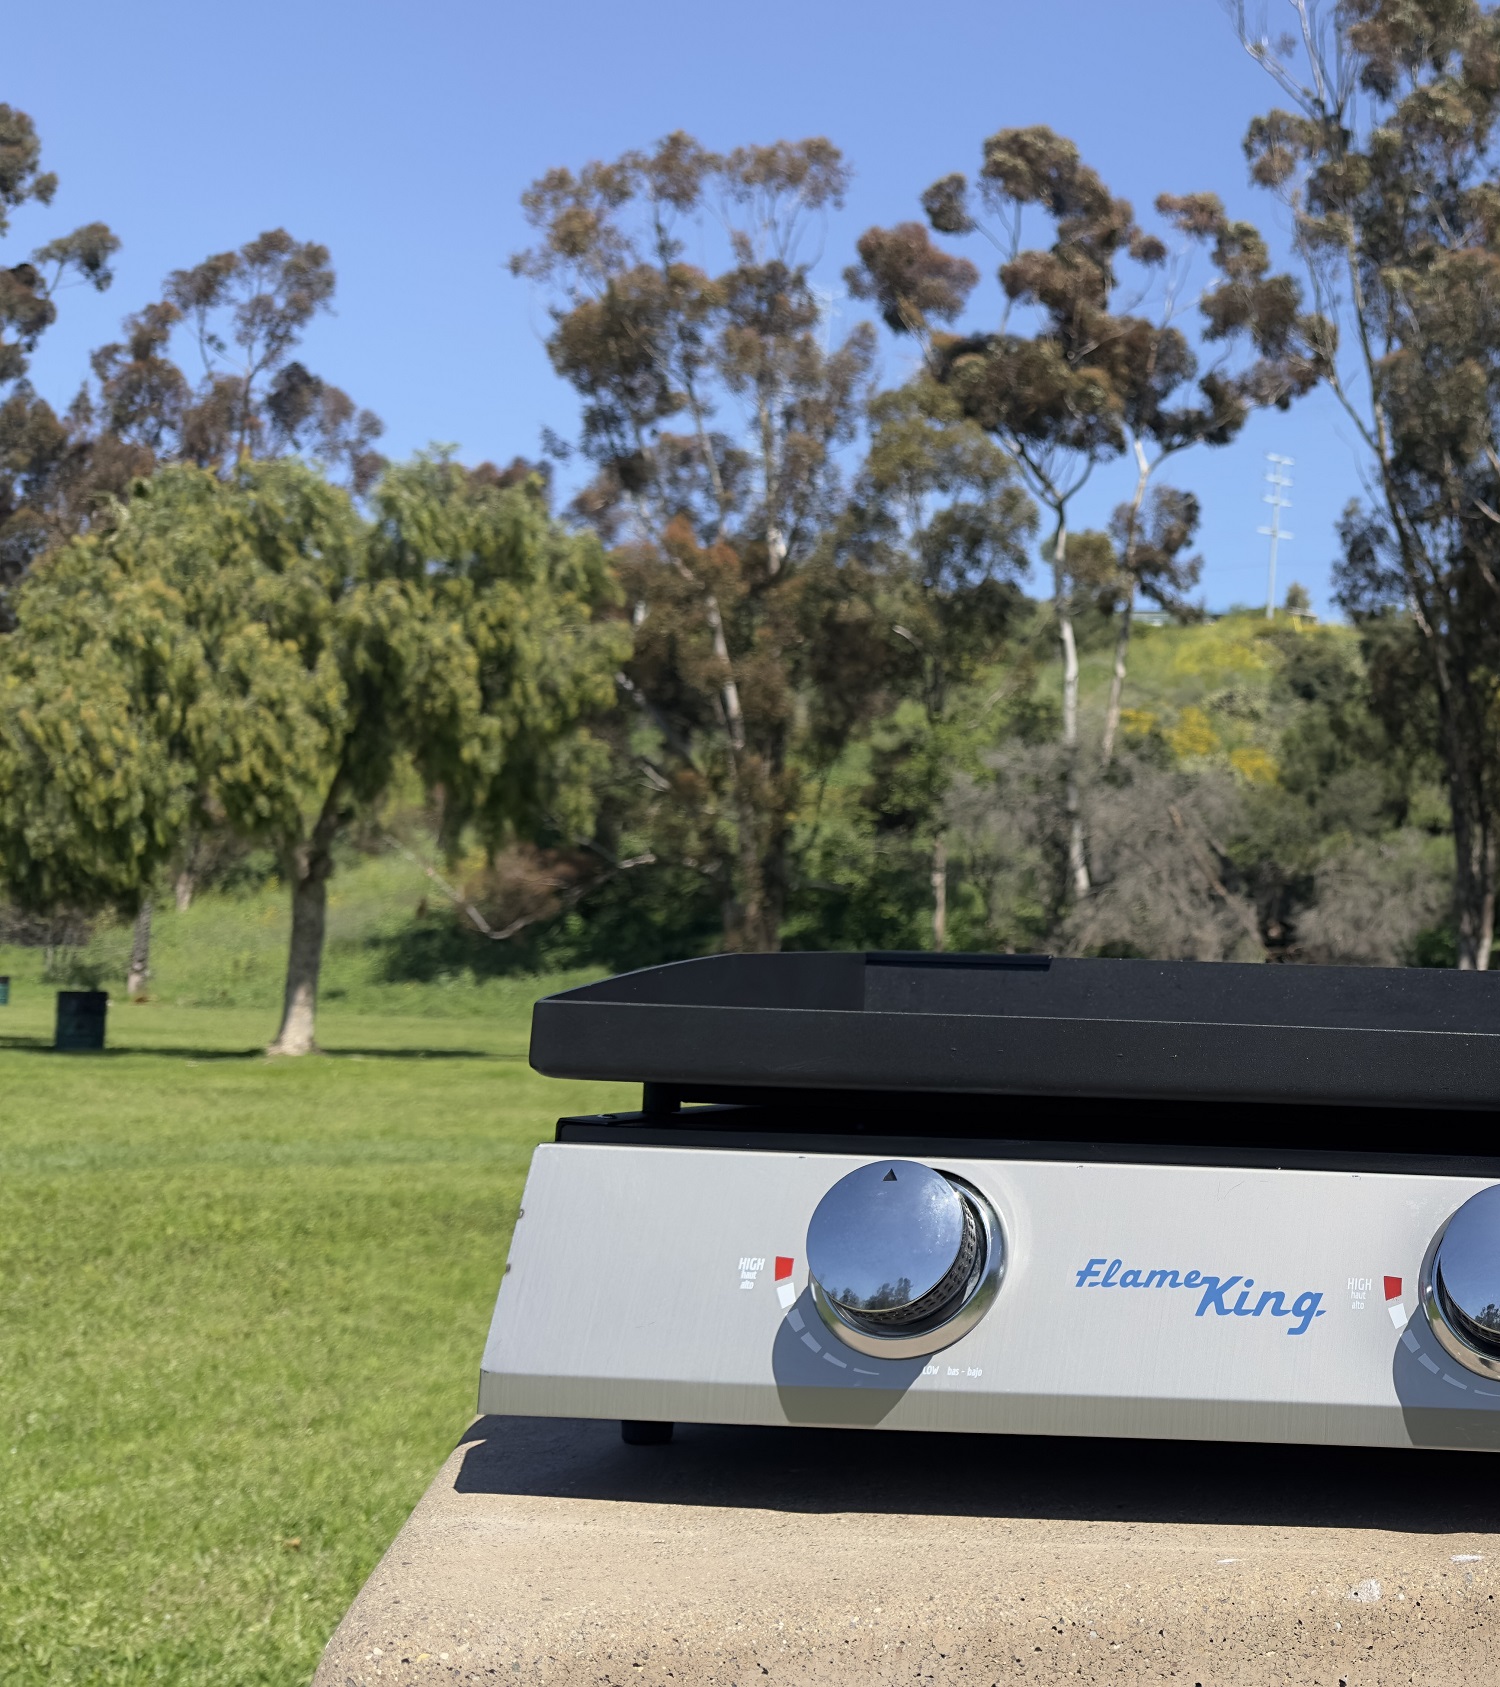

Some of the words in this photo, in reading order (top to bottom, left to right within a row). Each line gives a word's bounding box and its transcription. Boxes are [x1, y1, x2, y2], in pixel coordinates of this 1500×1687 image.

[738, 1257, 766, 1271] HIGH
[1347, 1277, 1372, 1291] HIGH
[1075, 1258, 1201, 1289] Flame
[1194, 1275, 1327, 1336] King
[1350, 1289, 1367, 1300] haut
[1351, 1300, 1365, 1310] alto
[922, 1365, 940, 1375] LOW
[947, 1366, 960, 1376] bas
[967, 1367, 982, 1378] bajo
